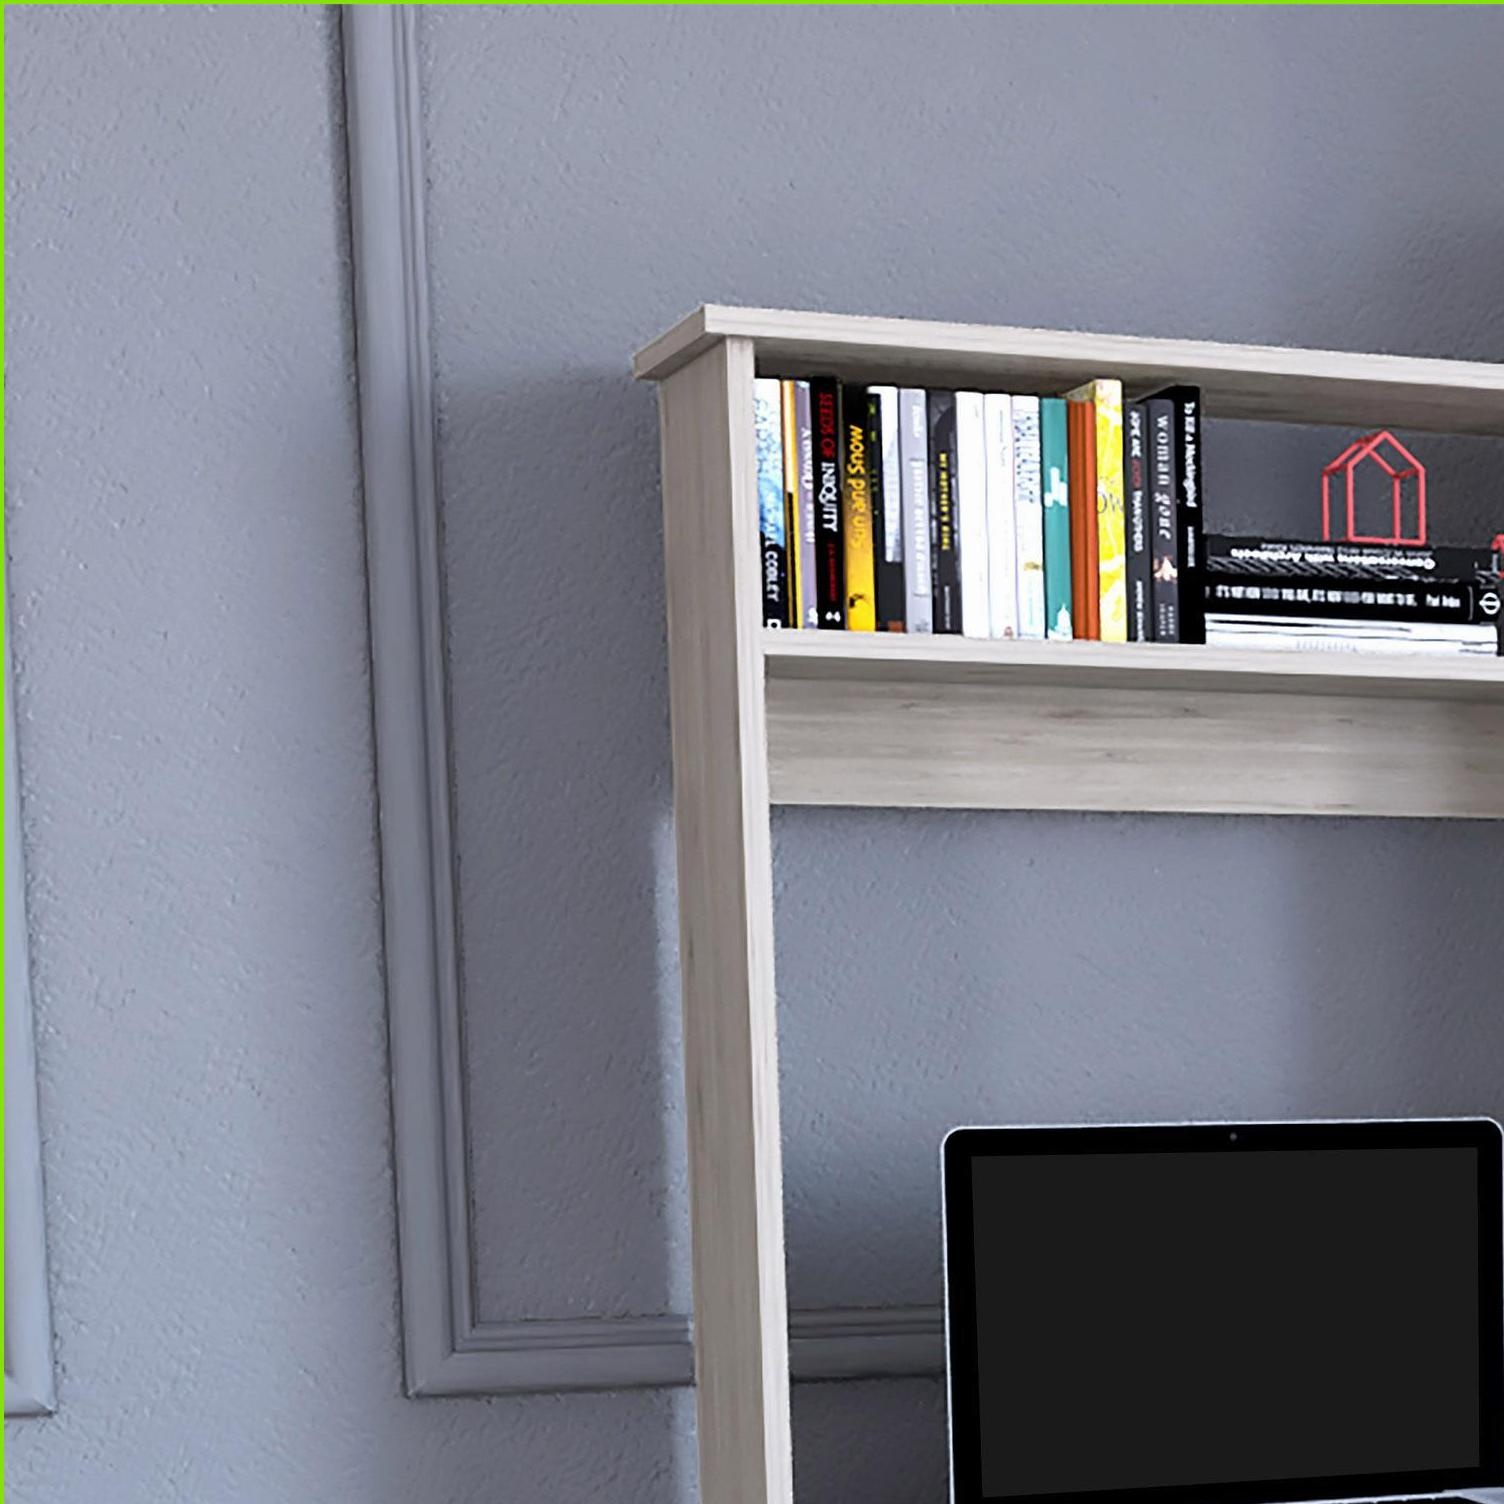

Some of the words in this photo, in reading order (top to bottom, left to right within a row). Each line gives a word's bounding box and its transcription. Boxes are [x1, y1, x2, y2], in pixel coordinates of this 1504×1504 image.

[819, 392, 834, 435] SEEDS
[1184, 402, 1195, 415] To
[1185, 416, 1196, 434] Kill
[820, 437, 835, 458] OF
[847, 425, 864, 474] Snow
[1156, 415, 1172, 486] woman
[1182, 444, 1197, 508] Mockingbird
[848, 479, 865, 513] and
[851, 516, 867, 548] Sun
[1155, 492, 1172, 540] gone
